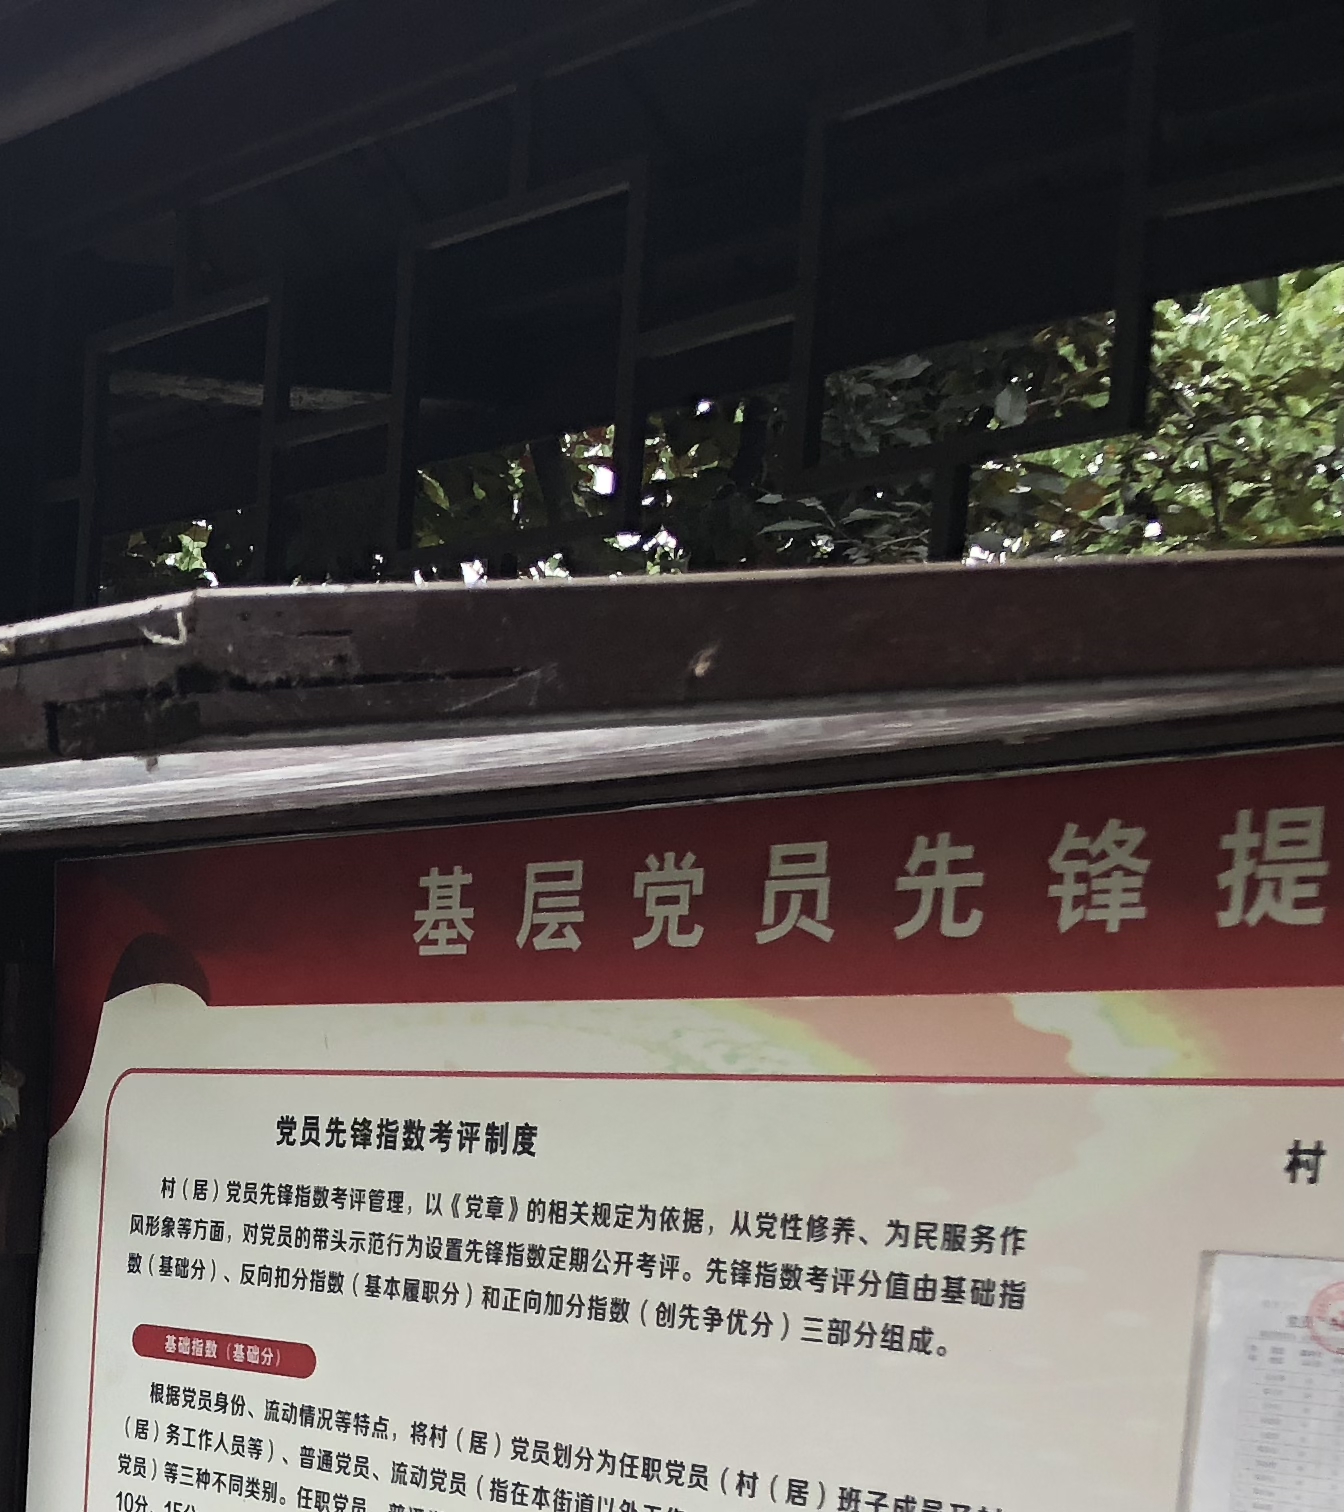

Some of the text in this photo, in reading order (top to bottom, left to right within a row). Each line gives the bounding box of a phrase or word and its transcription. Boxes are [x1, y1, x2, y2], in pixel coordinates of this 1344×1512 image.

[412, 805, 1331, 959] 基层党员先锋提
[275, 1114, 540, 1158] 党员先锋指数考评制度
[1283, 1138, 1328, 1184] 村
